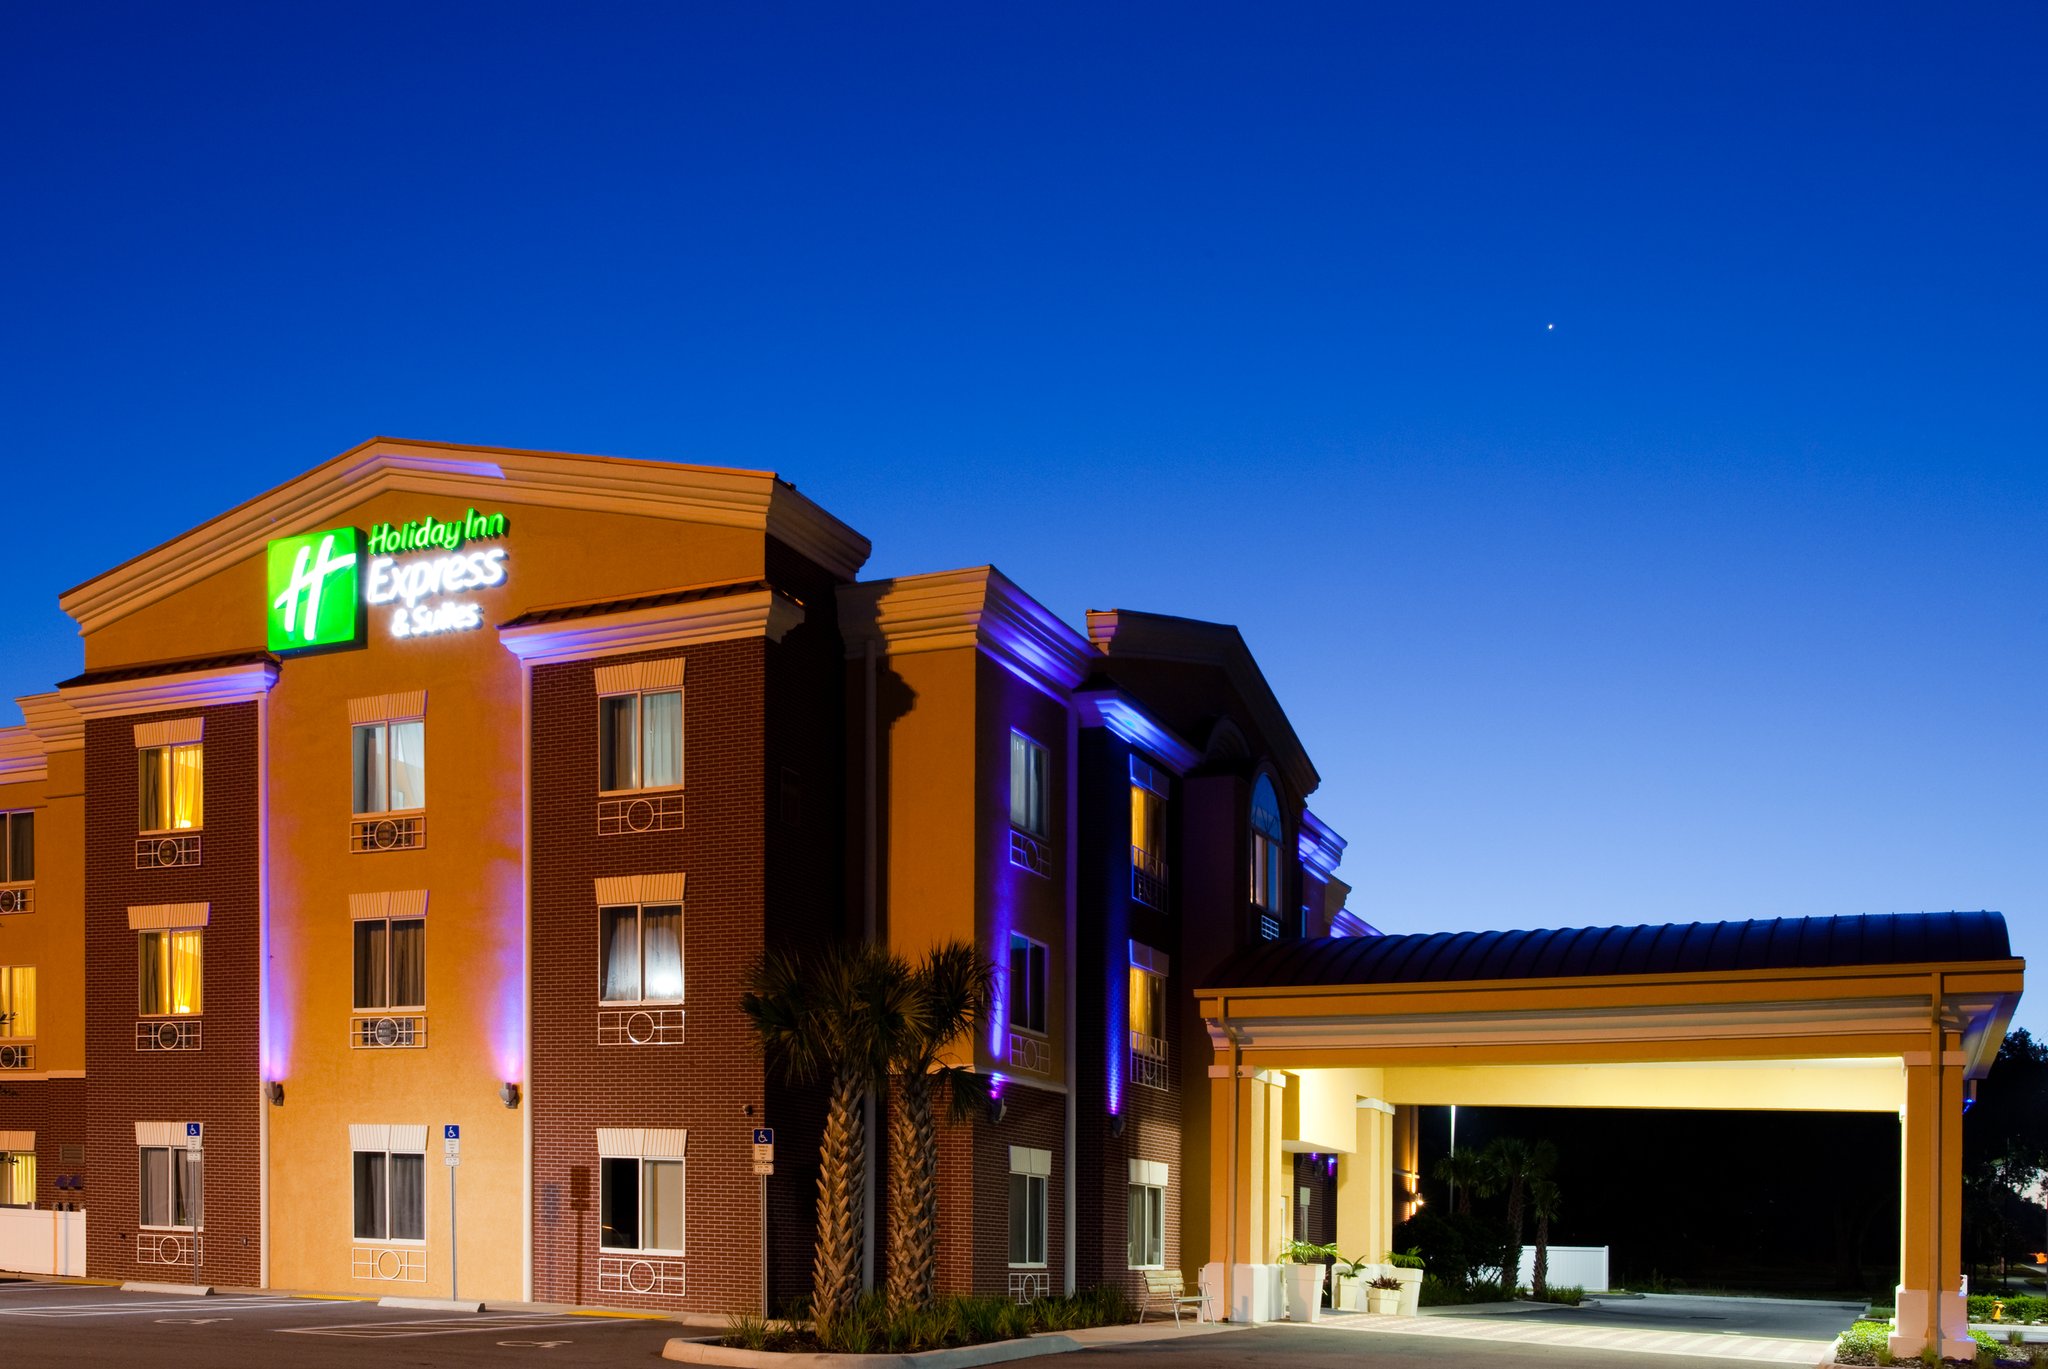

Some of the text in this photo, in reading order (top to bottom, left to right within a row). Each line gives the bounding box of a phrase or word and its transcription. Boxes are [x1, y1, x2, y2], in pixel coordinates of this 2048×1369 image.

[368, 507, 504, 555] Holiday Inn
[367, 548, 505, 608] Express
[391, 608, 411, 637] &
